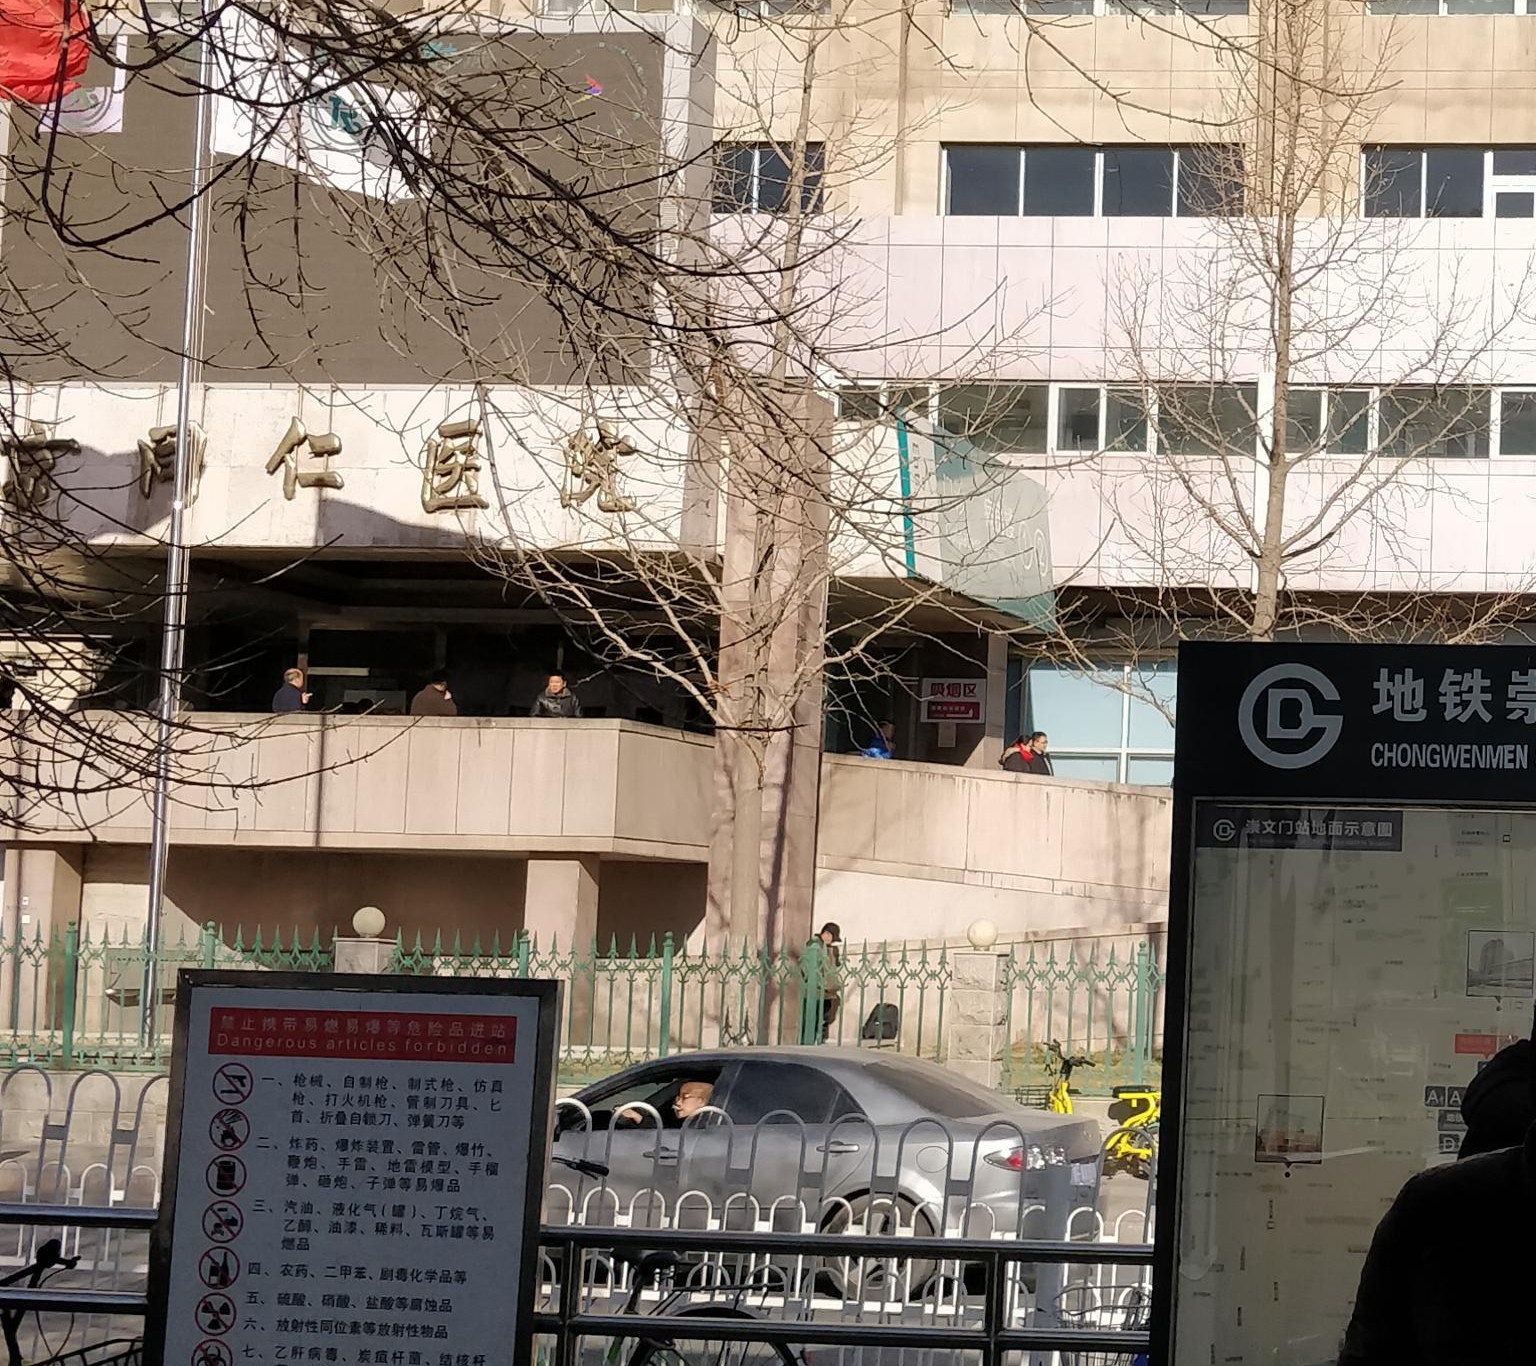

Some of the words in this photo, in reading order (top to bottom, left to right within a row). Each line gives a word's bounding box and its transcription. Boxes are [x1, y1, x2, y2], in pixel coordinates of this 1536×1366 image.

[1370, 742, 1529, 770] CHONGWENMEN
[1246, 818, 1393, 838] 崇文门站地面示意图
[220, 1014, 506, 1038] 禁止携带易燃易爆等危险品进站
[216, 1034, 317, 1050] Dangerous
[326, 1037, 396, 1053] articles
[405, 1037, 508, 1056] forbidden
